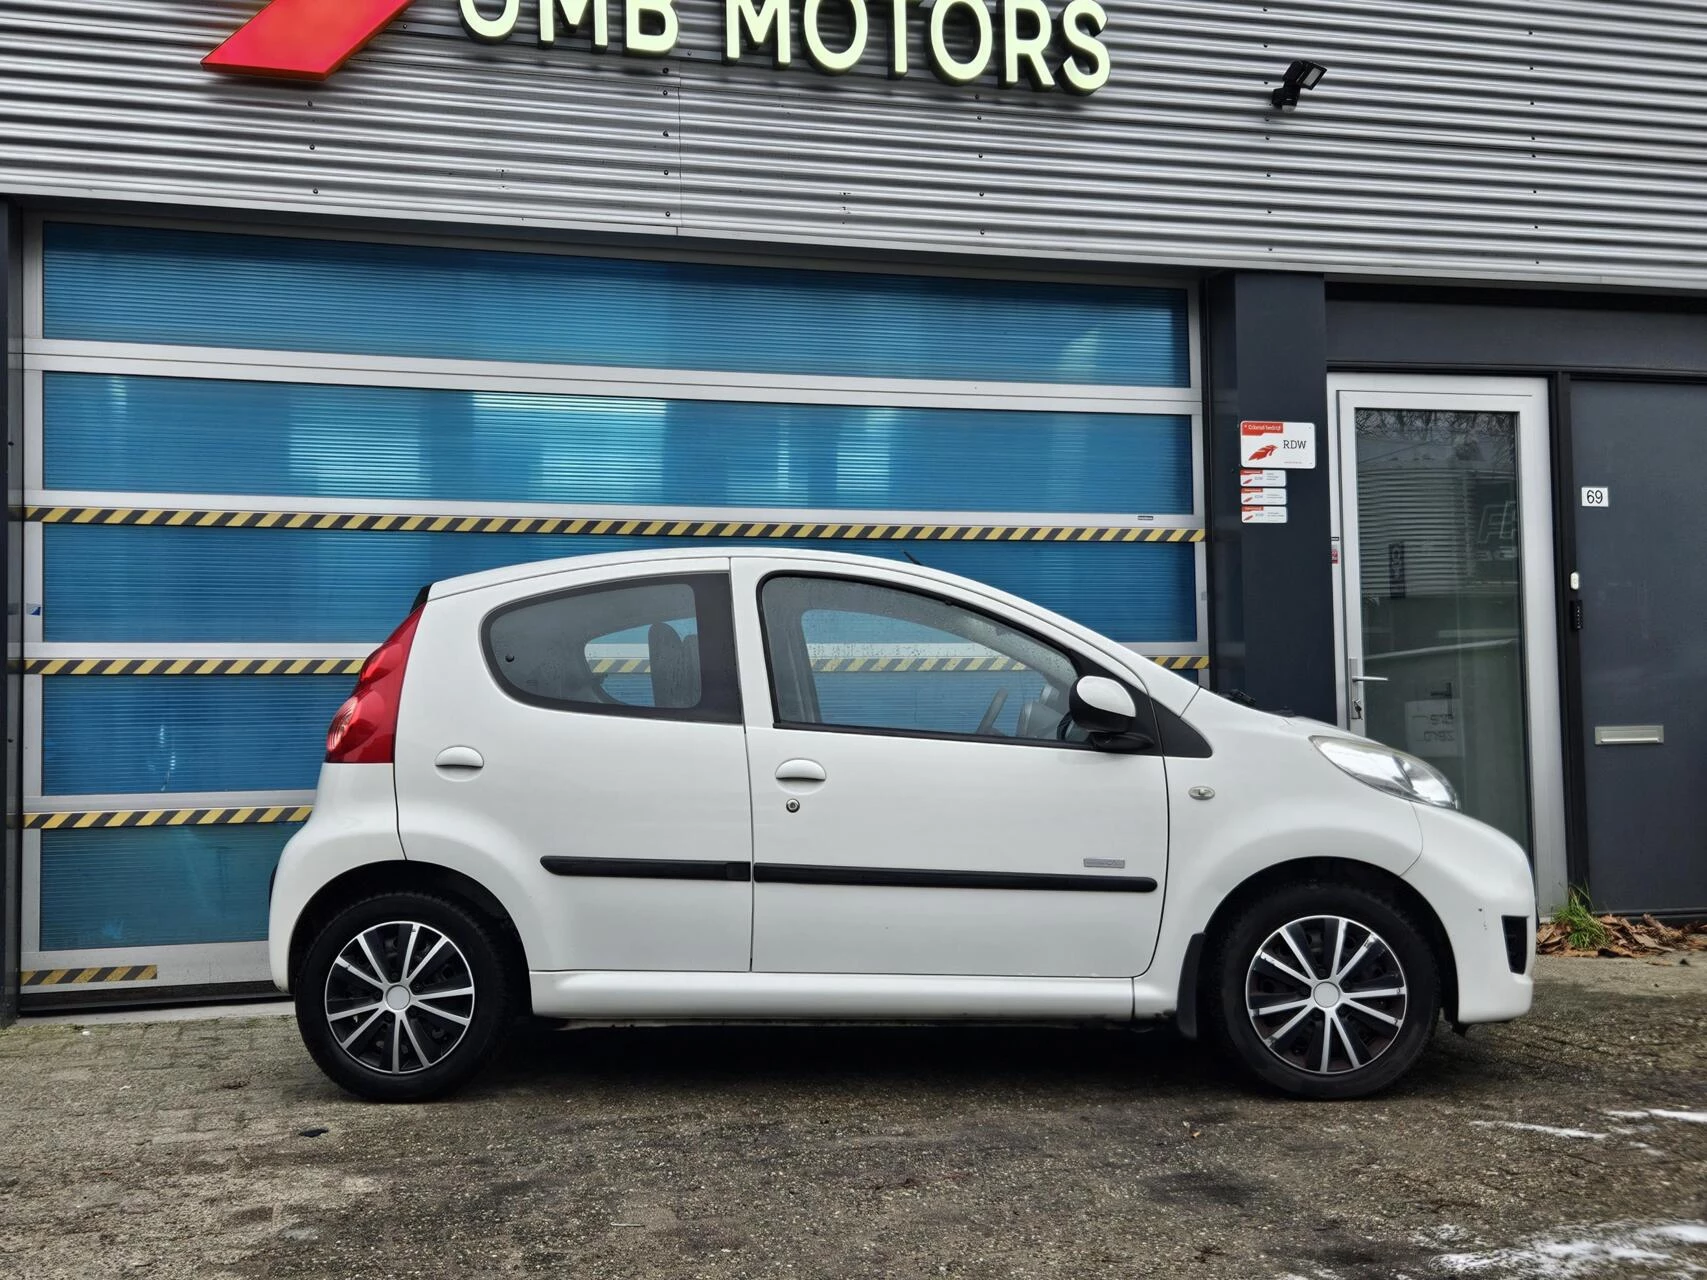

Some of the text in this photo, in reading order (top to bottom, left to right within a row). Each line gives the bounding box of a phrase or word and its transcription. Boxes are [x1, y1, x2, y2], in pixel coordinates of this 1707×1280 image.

[726, 0, 1111, 91] MOTORS
[1283, 439, 1307, 449] RDW
[1586, 489, 1603, 505] 69
